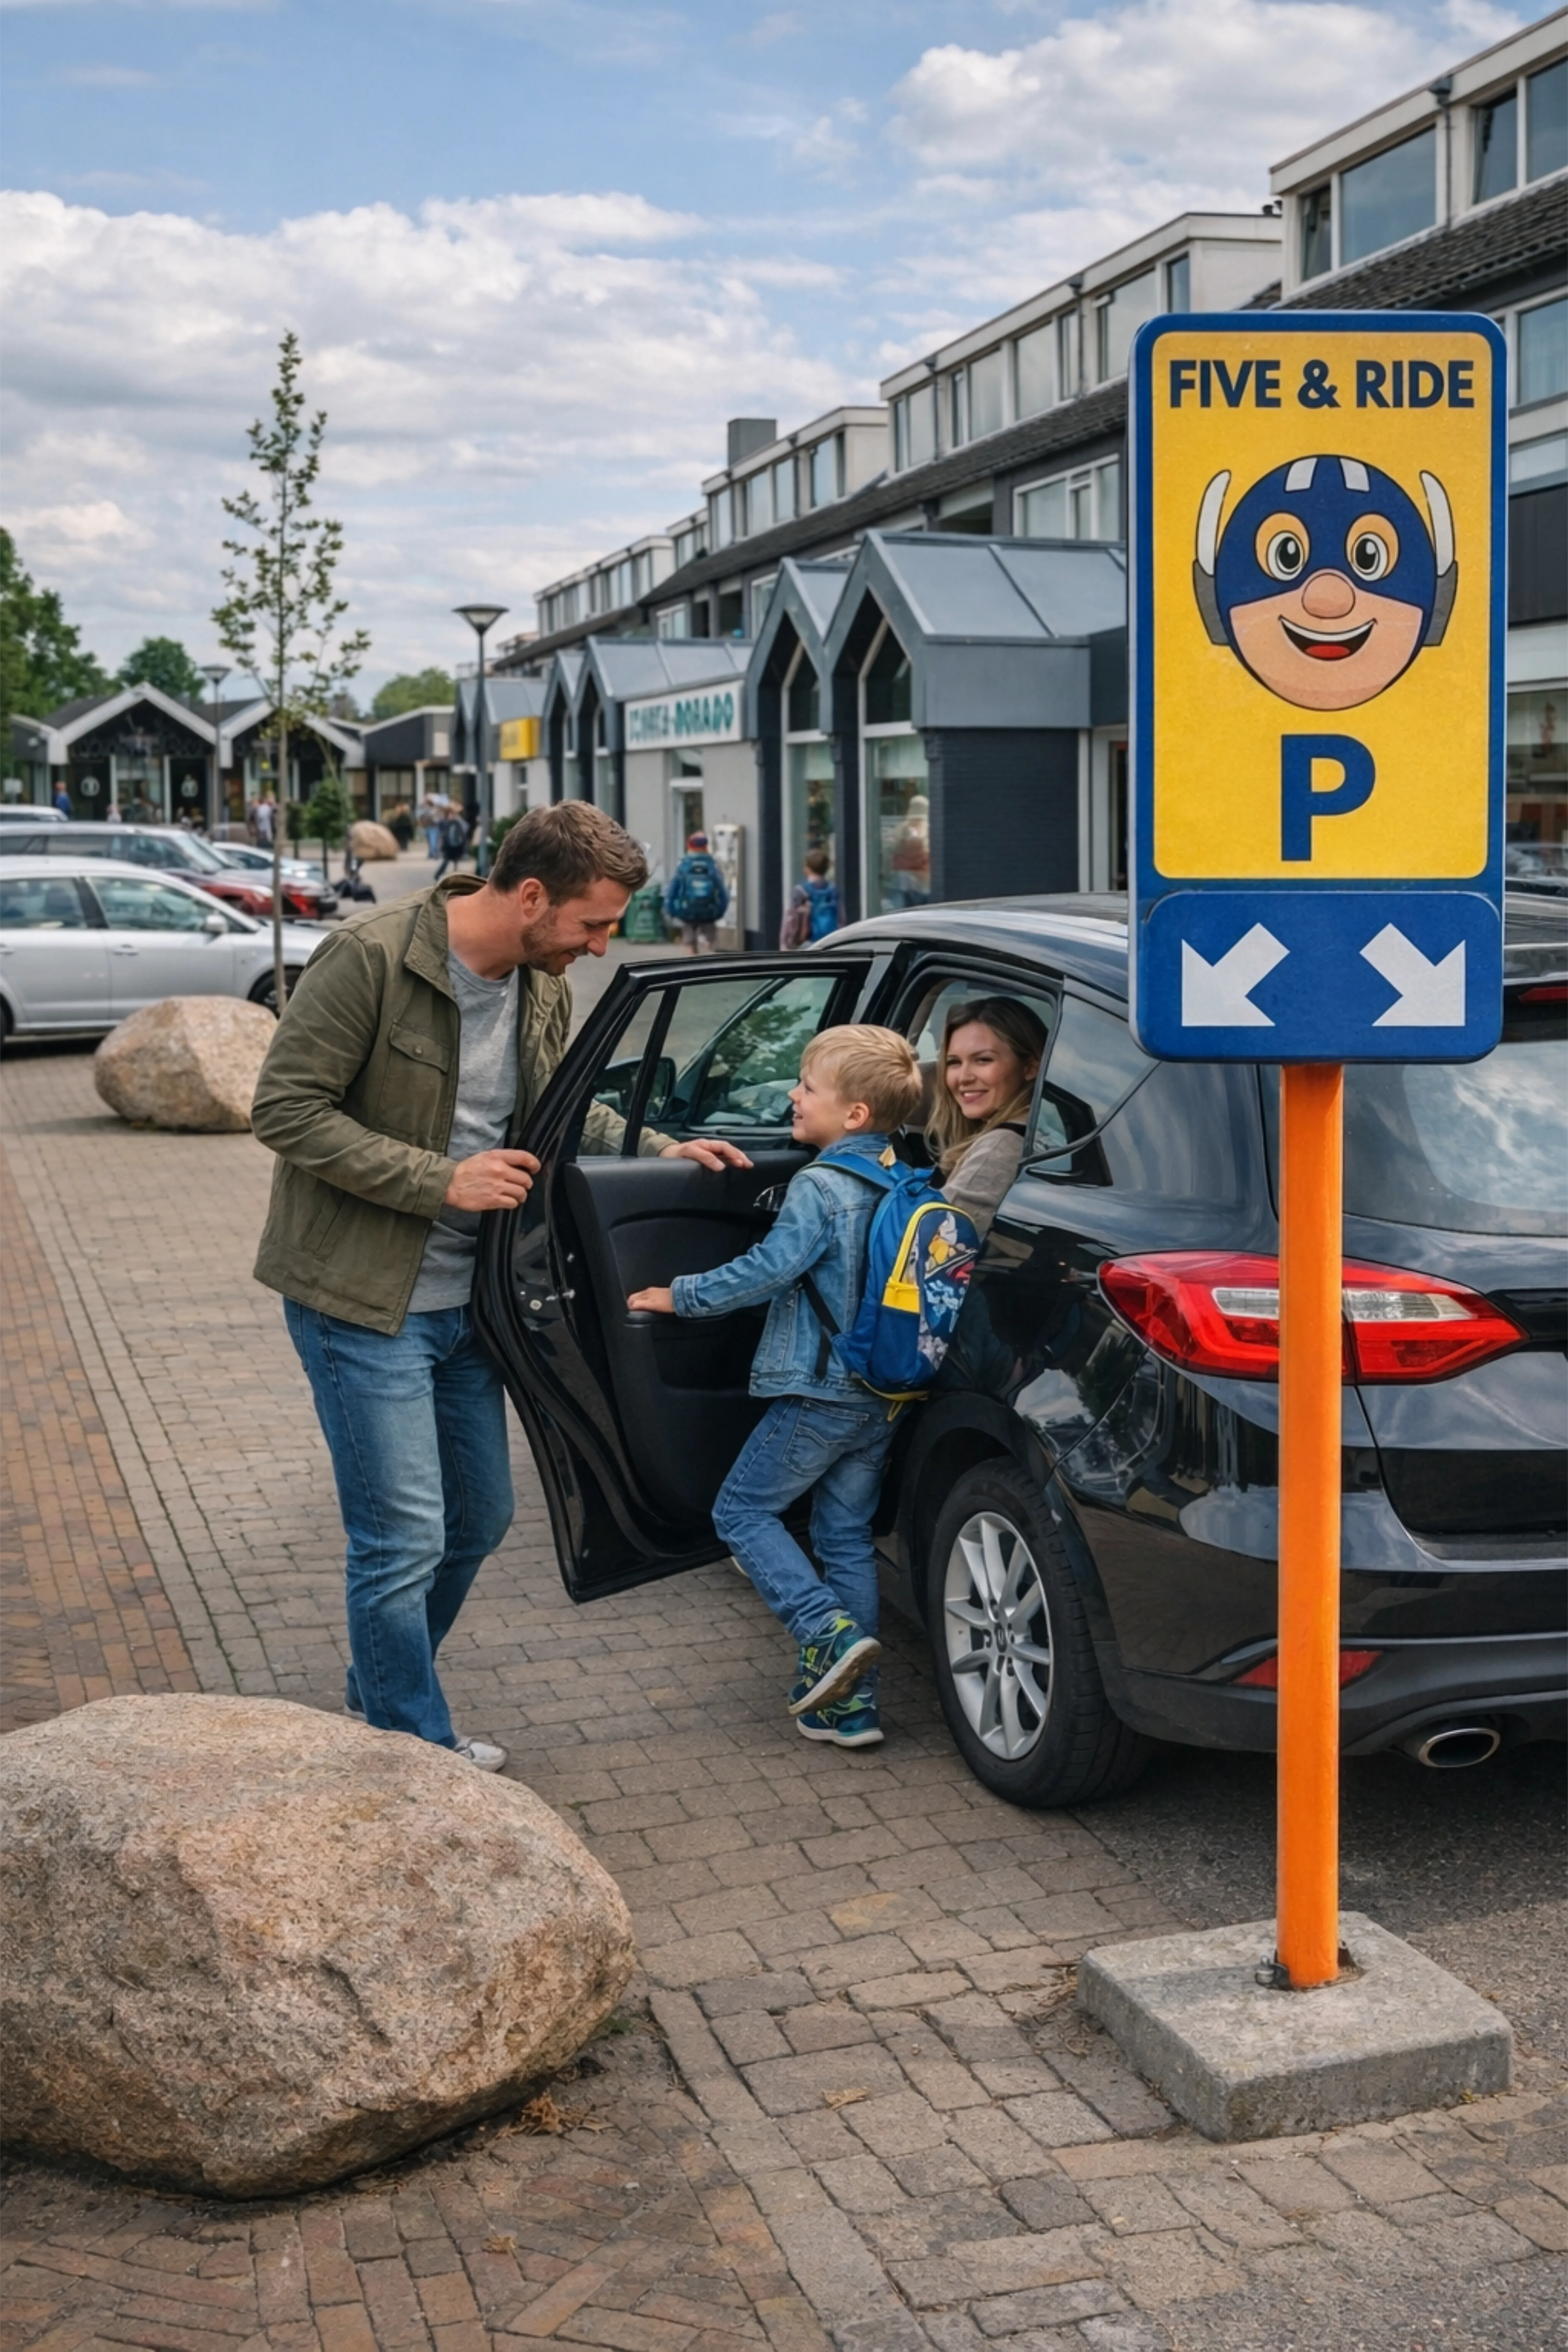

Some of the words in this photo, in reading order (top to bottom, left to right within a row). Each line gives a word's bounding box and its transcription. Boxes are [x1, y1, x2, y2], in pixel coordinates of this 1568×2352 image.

[1170, 360, 1281, 409] FIVE
[1297, 360, 1341, 409] &
[1356, 360, 1475, 409] RIDE
[1281, 734, 1375, 861] P
